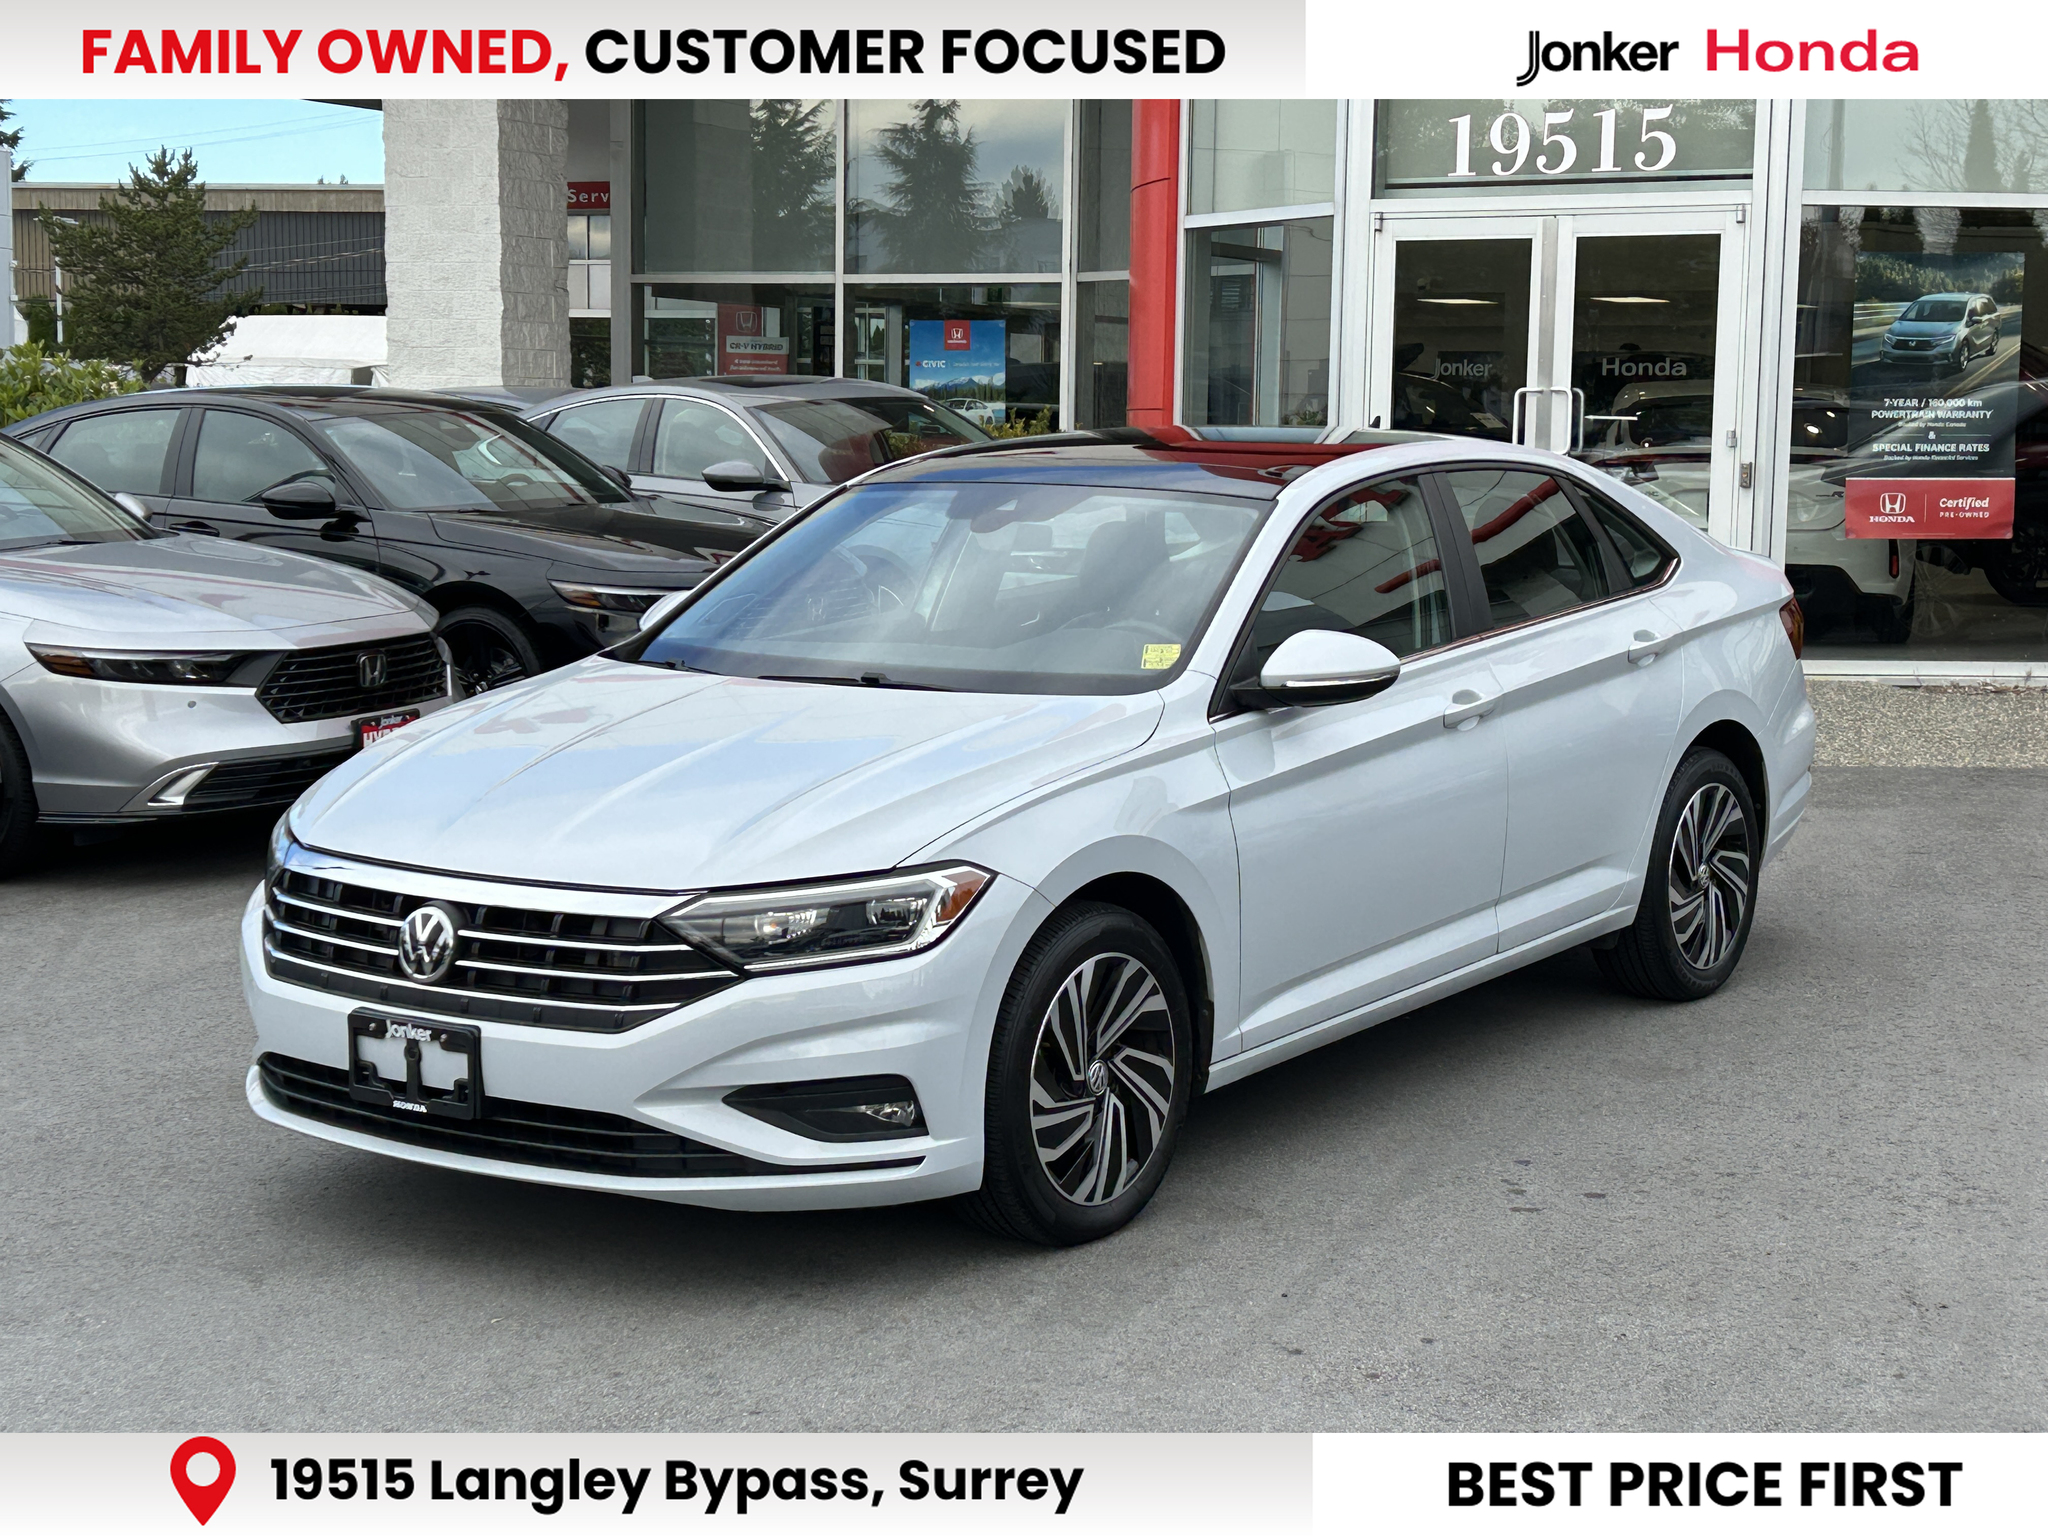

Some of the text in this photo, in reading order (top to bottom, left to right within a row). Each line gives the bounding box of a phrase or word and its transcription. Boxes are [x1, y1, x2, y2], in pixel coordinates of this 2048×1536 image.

[1448, 104, 1677, 178] 19515
[922, 360, 946, 368] CIVIC
[1602, 357, 1687, 376] Honda
[1430, 358, 1493, 380] Jonker
[1967, 398, 1983, 407] km
[1871, 409, 1993, 419] POWERTRAIN WARRANTY
[1927, 431, 1936, 440] &
[1872, 443, 1990, 452] SPECIAL FINANCE RATES
[1939, 496, 1990, 510] Certified
[1869, 515, 1915, 523] HONDA
